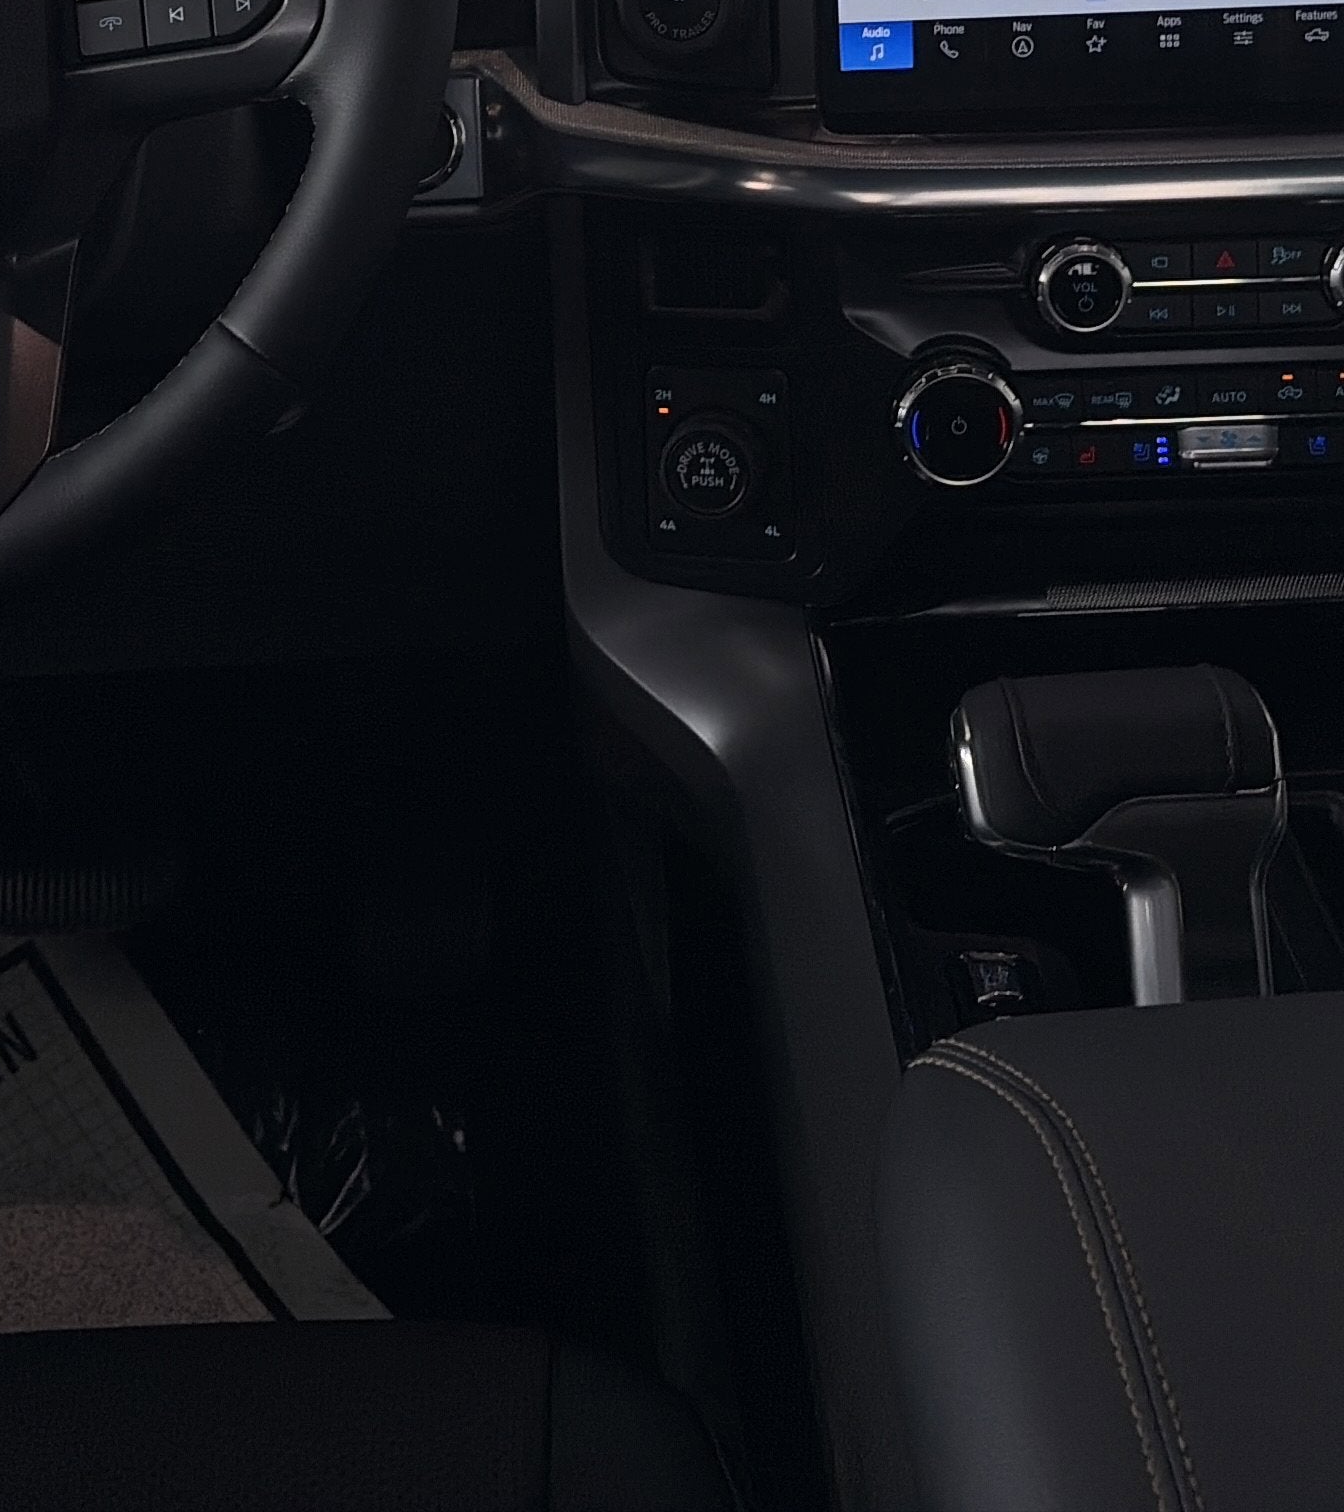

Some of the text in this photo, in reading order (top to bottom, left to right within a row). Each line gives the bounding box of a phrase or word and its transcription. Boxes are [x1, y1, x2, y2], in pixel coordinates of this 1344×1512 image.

[1157, 15, 1182, 28] Apps
[1223, 12, 1263, 25] Settings
[1295, 10, 1338, 22] Features
[934, 23, 965, 35] Phone
[1013, 21, 1033, 32] Nav
[1086, 18, 1105, 30] Fav
[862, 26, 890, 38] Audio
[1072, 282, 1098, 292] VOL
[654, 389, 672, 401] 2H
[758, 393, 777, 404] 4H
[1211, 391, 1247, 404] AUTO
[676, 441, 740, 474] DRIVE MODE
[691, 475, 724, 487] PUSH
[659, 519, 676, 531] 4A
[764, 525, 781, 537] 4L
